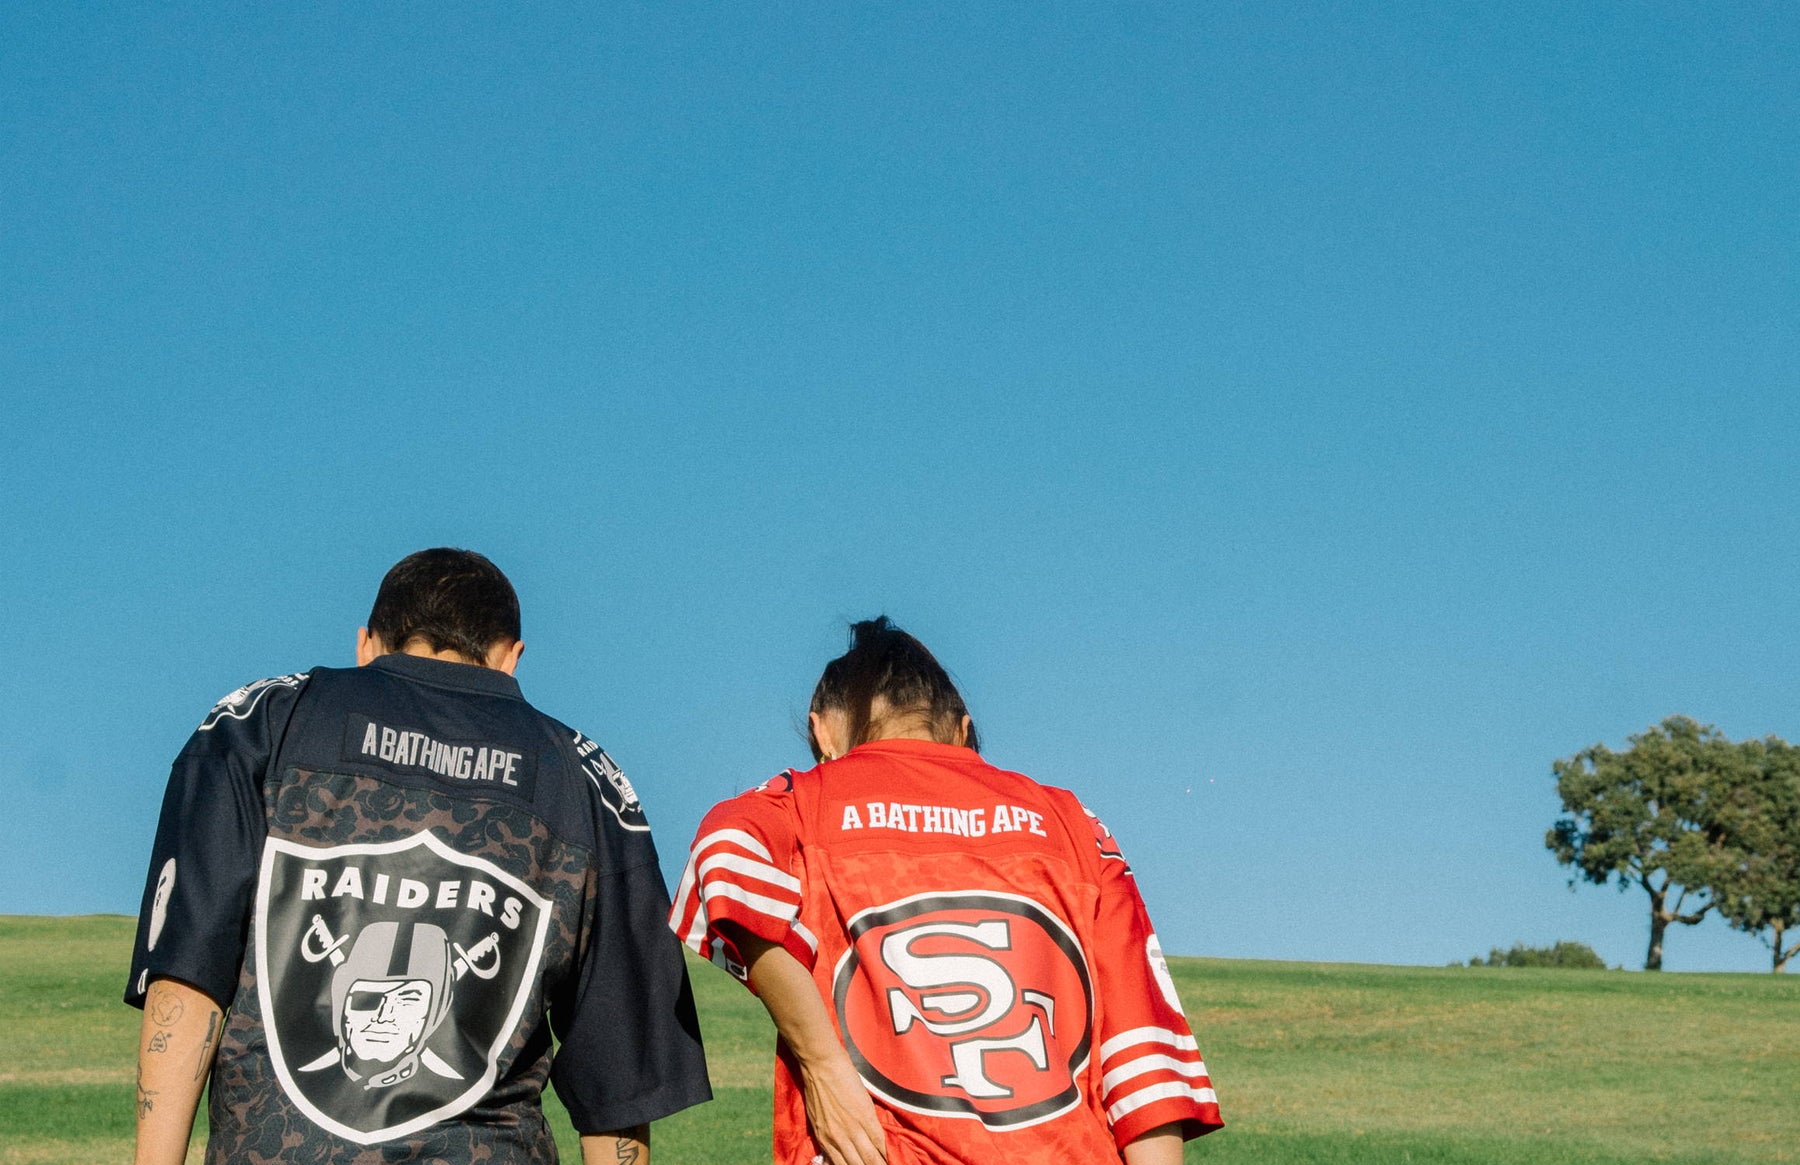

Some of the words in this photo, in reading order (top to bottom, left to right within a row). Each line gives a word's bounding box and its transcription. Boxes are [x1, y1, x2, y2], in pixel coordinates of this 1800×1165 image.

[361, 722, 377, 756] A
[379, 726, 474, 780] BATHING
[472, 747, 523, 787] APE
[841, 805, 863, 831] A
[866, 802, 986, 838] BATHING
[991, 804, 1048, 838] APE
[301, 866, 524, 930] RAIDERS
